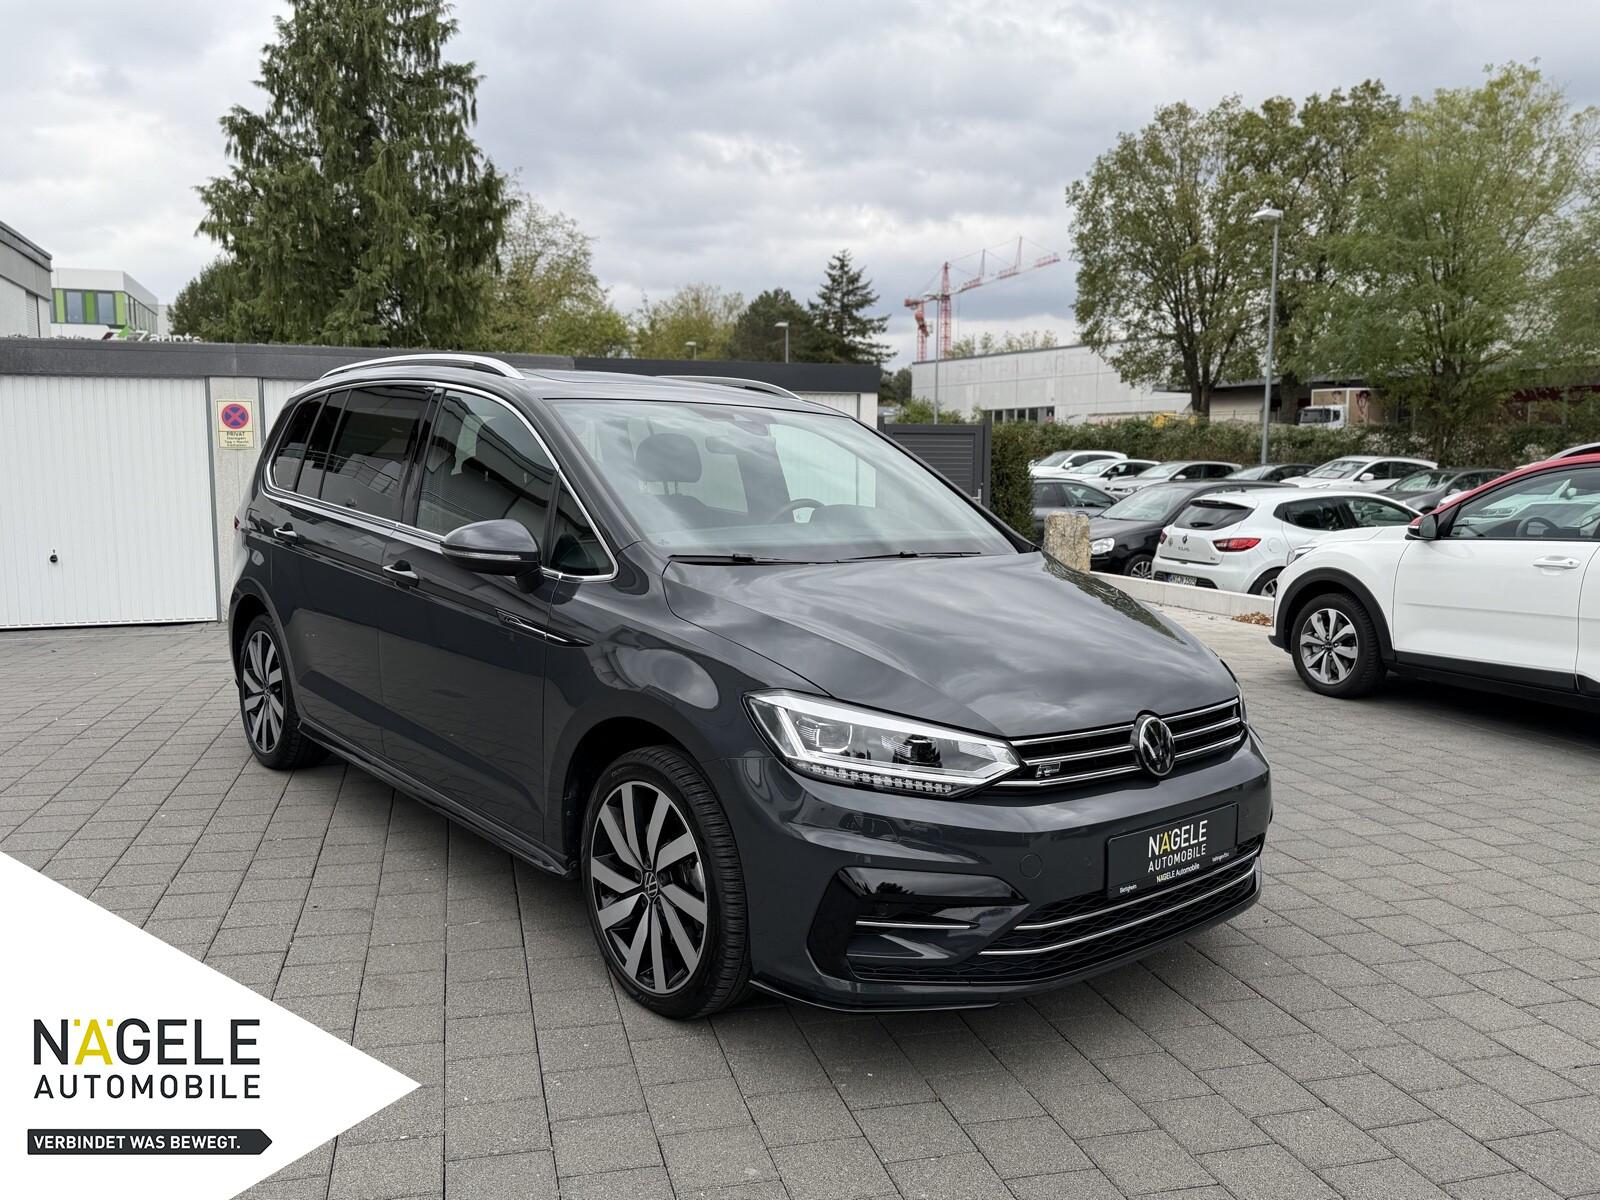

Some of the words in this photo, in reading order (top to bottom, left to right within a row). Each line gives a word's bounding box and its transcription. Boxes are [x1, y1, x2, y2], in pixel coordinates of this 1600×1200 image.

[1148, 820, 1208, 858] NÄGELE
[1147, 843, 1207, 873] AUTOMOBILE
[1175, 863, 1200, 876] Automobile
